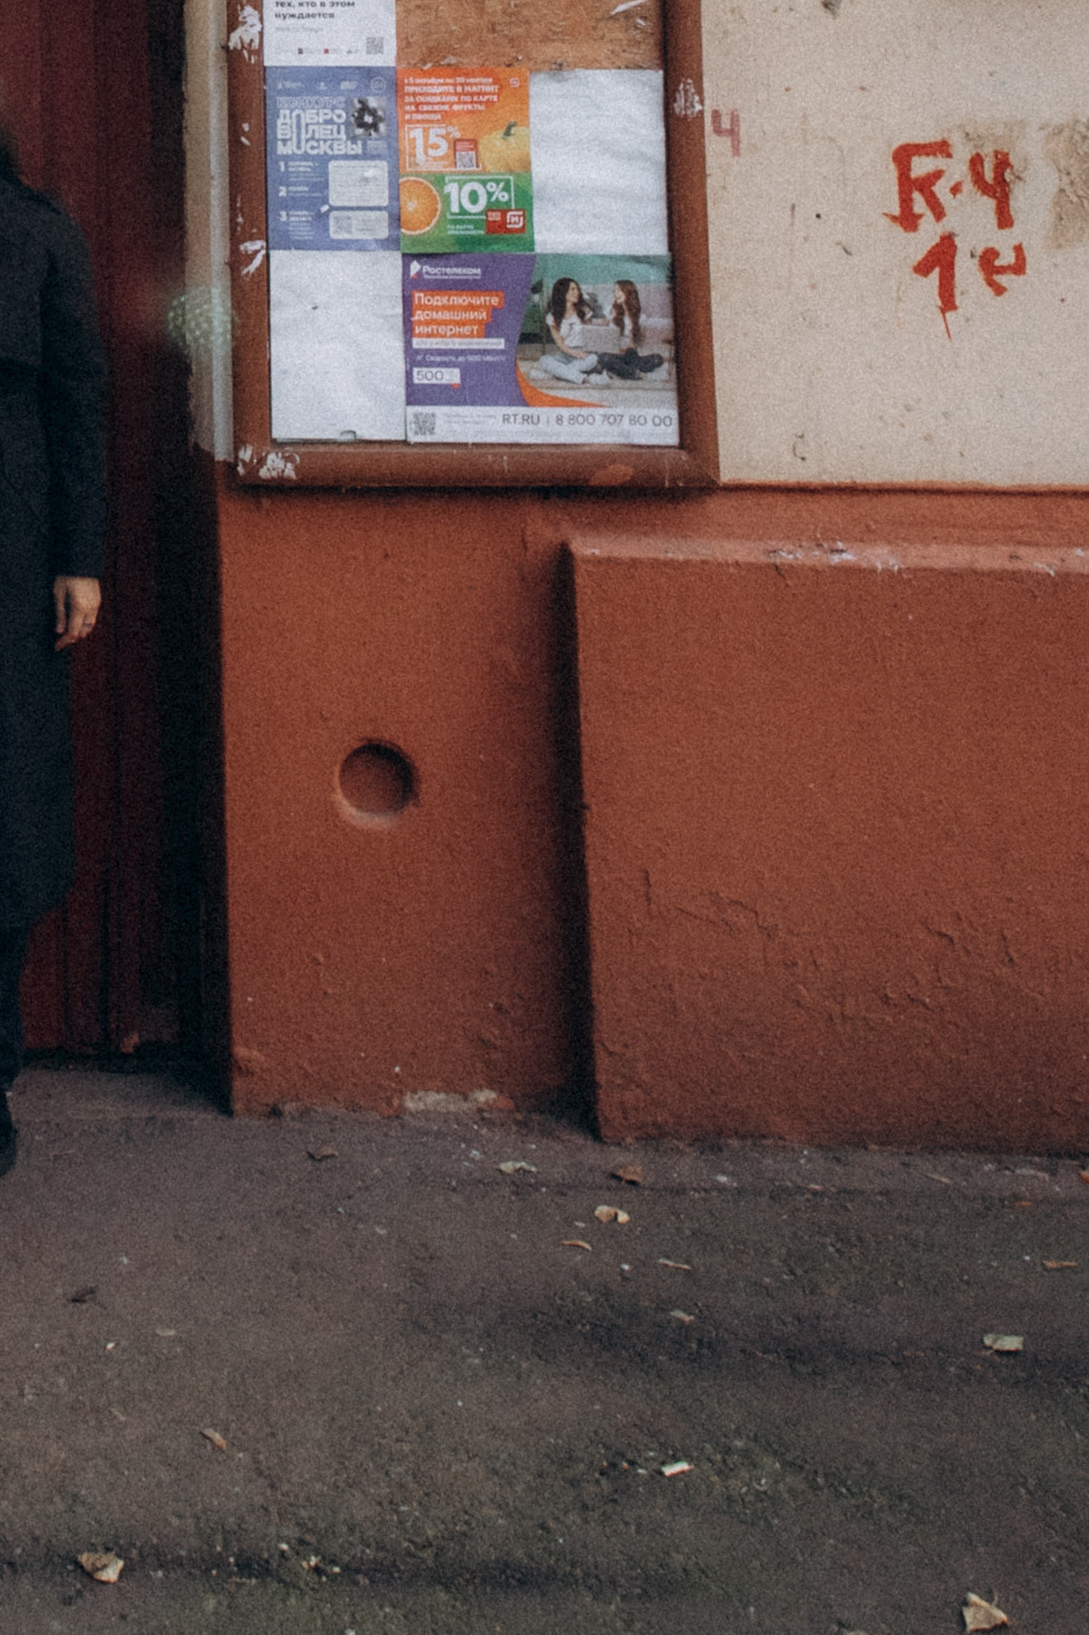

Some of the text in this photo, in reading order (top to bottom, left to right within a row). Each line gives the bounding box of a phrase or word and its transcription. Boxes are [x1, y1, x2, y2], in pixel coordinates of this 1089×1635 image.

[275, 1, 296, 9] тех,
[274, 12, 335, 20] нуждается
[277, 140, 363, 155] МОСКВЫ
[278, 161, 285, 172] 1
[278, 186, 287, 197] 2
[444, 181, 510, 213] 10%
[279, 211, 287, 222] 3
[422, 266, 481, 275] Ростелеком
[414, 292, 499, 306] Подключите
[414, 308, 487, 321] домашний
[415, 325, 479, 337] интернет
[416, 370, 444, 381] 500
[503, 414, 541, 425] RT.RU
[555, 414, 673, 427] 8 800 707 80 00
